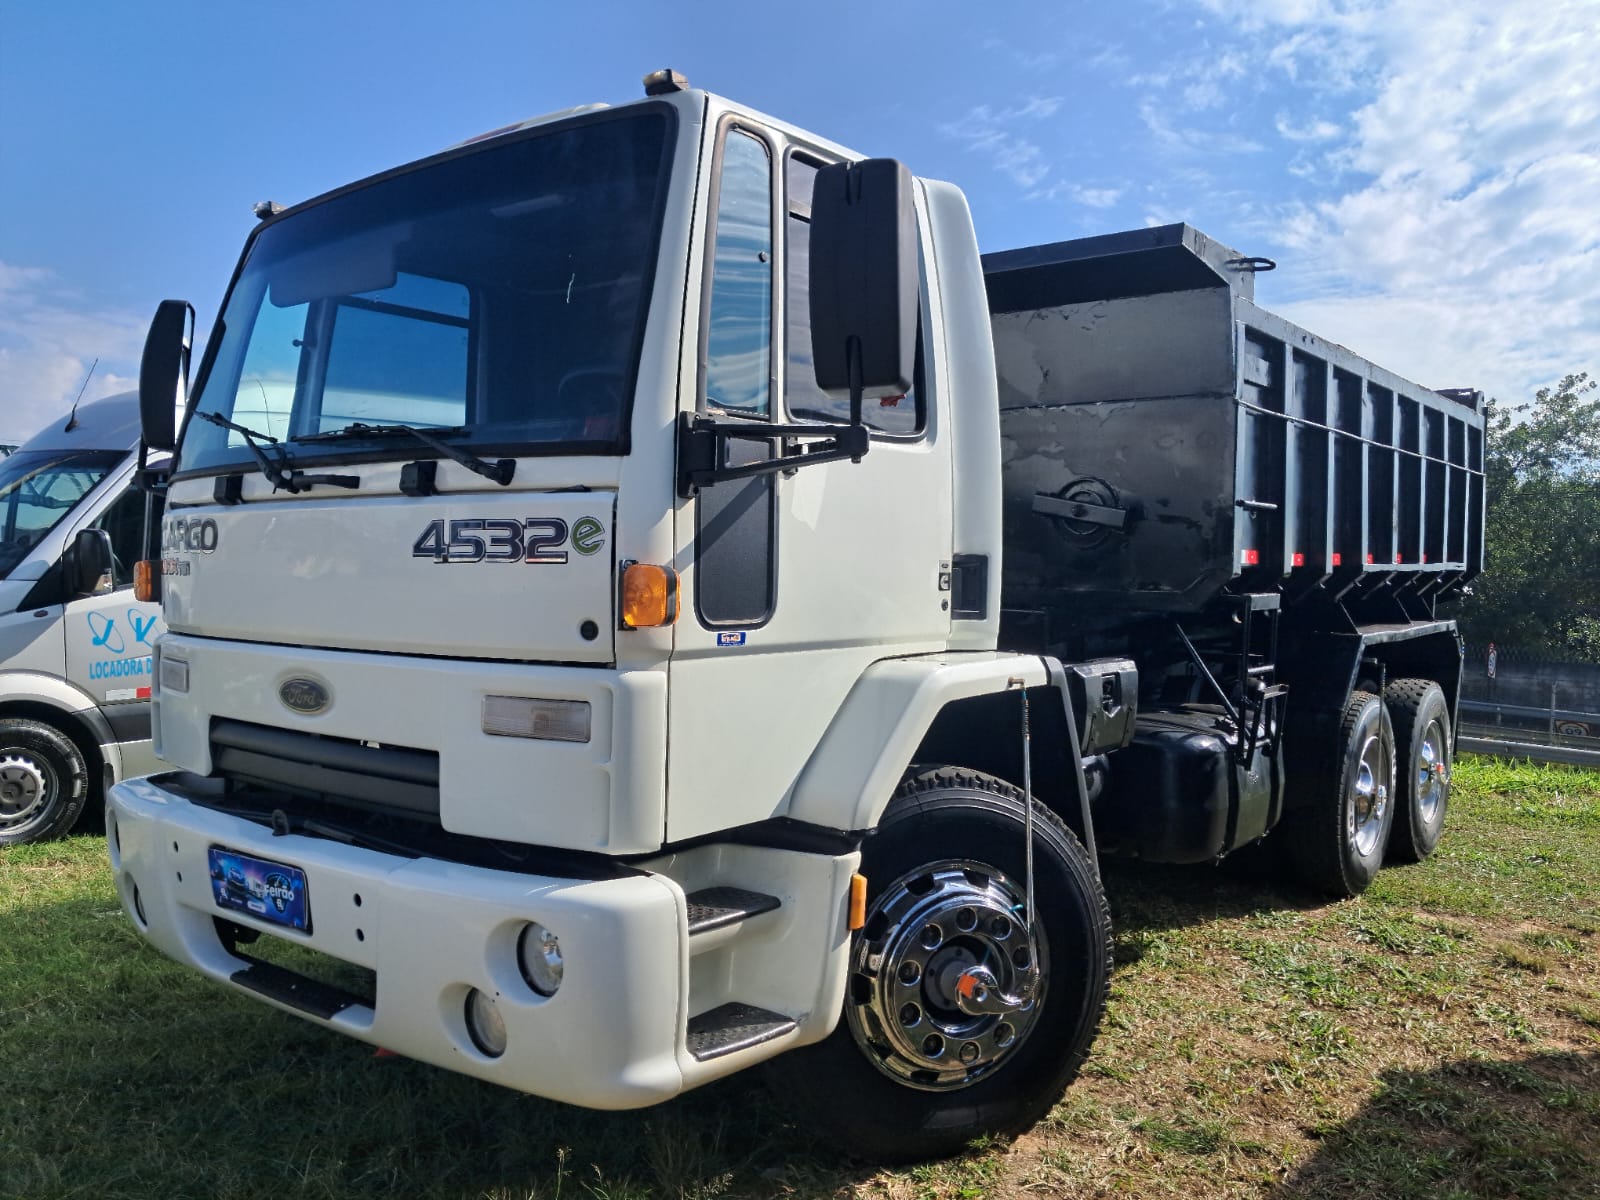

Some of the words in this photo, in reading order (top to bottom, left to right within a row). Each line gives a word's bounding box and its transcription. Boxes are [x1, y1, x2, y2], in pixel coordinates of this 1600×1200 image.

[89, 659, 143, 679] LOCADORA
[287, 686, 318, 706] Ford
[264, 883, 295, 901] Feirão
